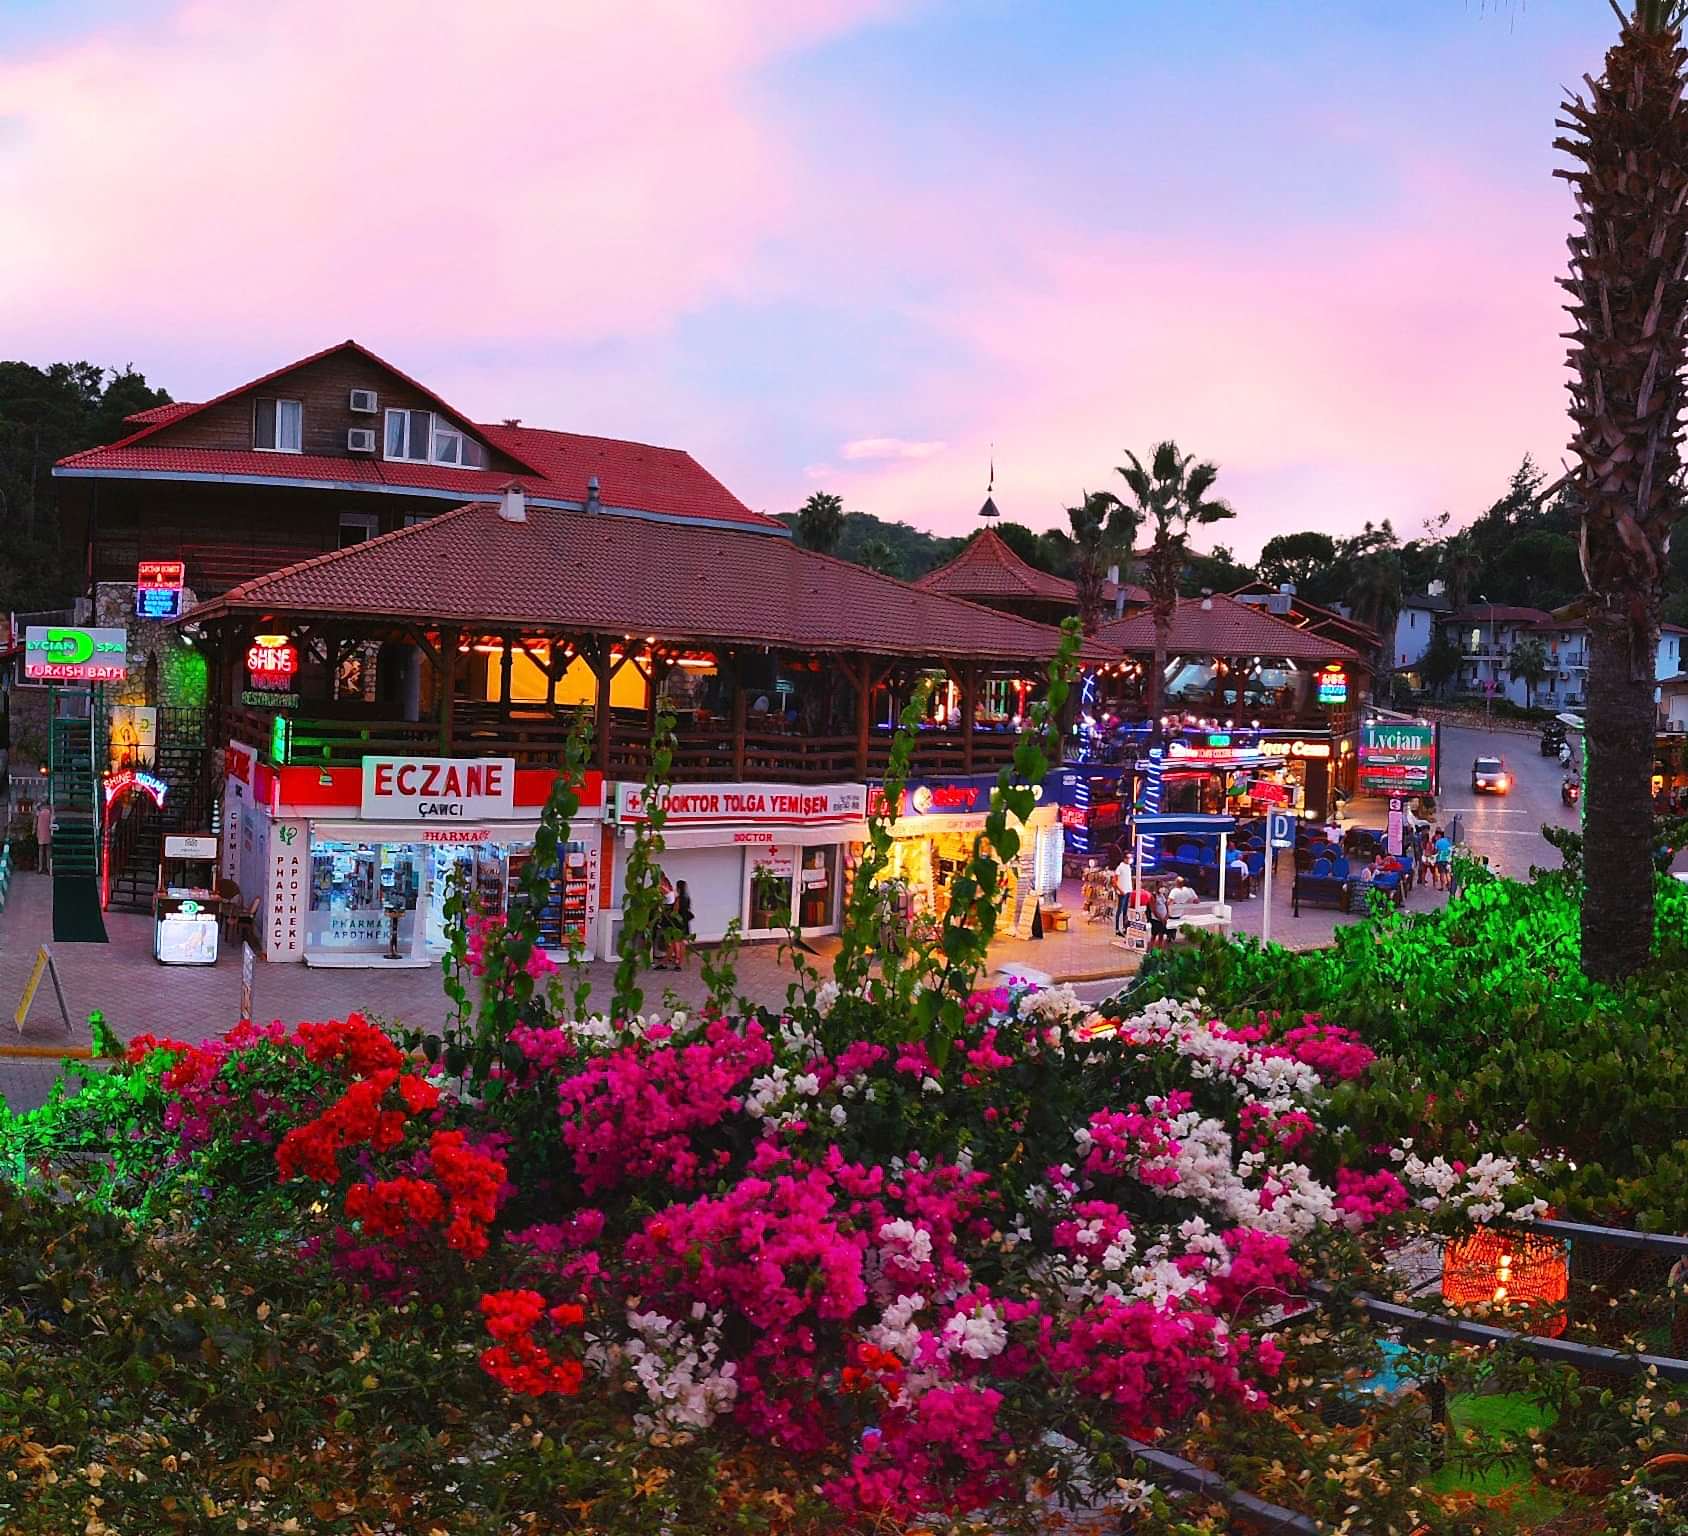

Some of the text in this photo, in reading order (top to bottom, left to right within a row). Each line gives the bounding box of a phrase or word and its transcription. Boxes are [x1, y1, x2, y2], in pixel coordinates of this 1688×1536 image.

[27, 641, 75, 651] LYCIAN
[96, 642, 124, 652] SPA
[247, 647, 292, 672] SHINE
[26, 665, 124, 680] TURKISH BATH
[1369, 730, 1422, 751] Lycian
[103, 770, 132, 787] SHINE
[374, 763, 503, 798] ECZANE
[662, 795, 719, 813] DOKTOR
[723, 794, 766, 812] TOLGA
[735, 833, 773, 842] DOCTOR
[1275, 815, 1289, 838] D
[229, 812, 238, 880] CHEMIST
[587, 849, 597, 925] CHEMIST
[274, 856, 284, 950] PHARMACY
[289, 856, 299, 950] APOTHEKE
